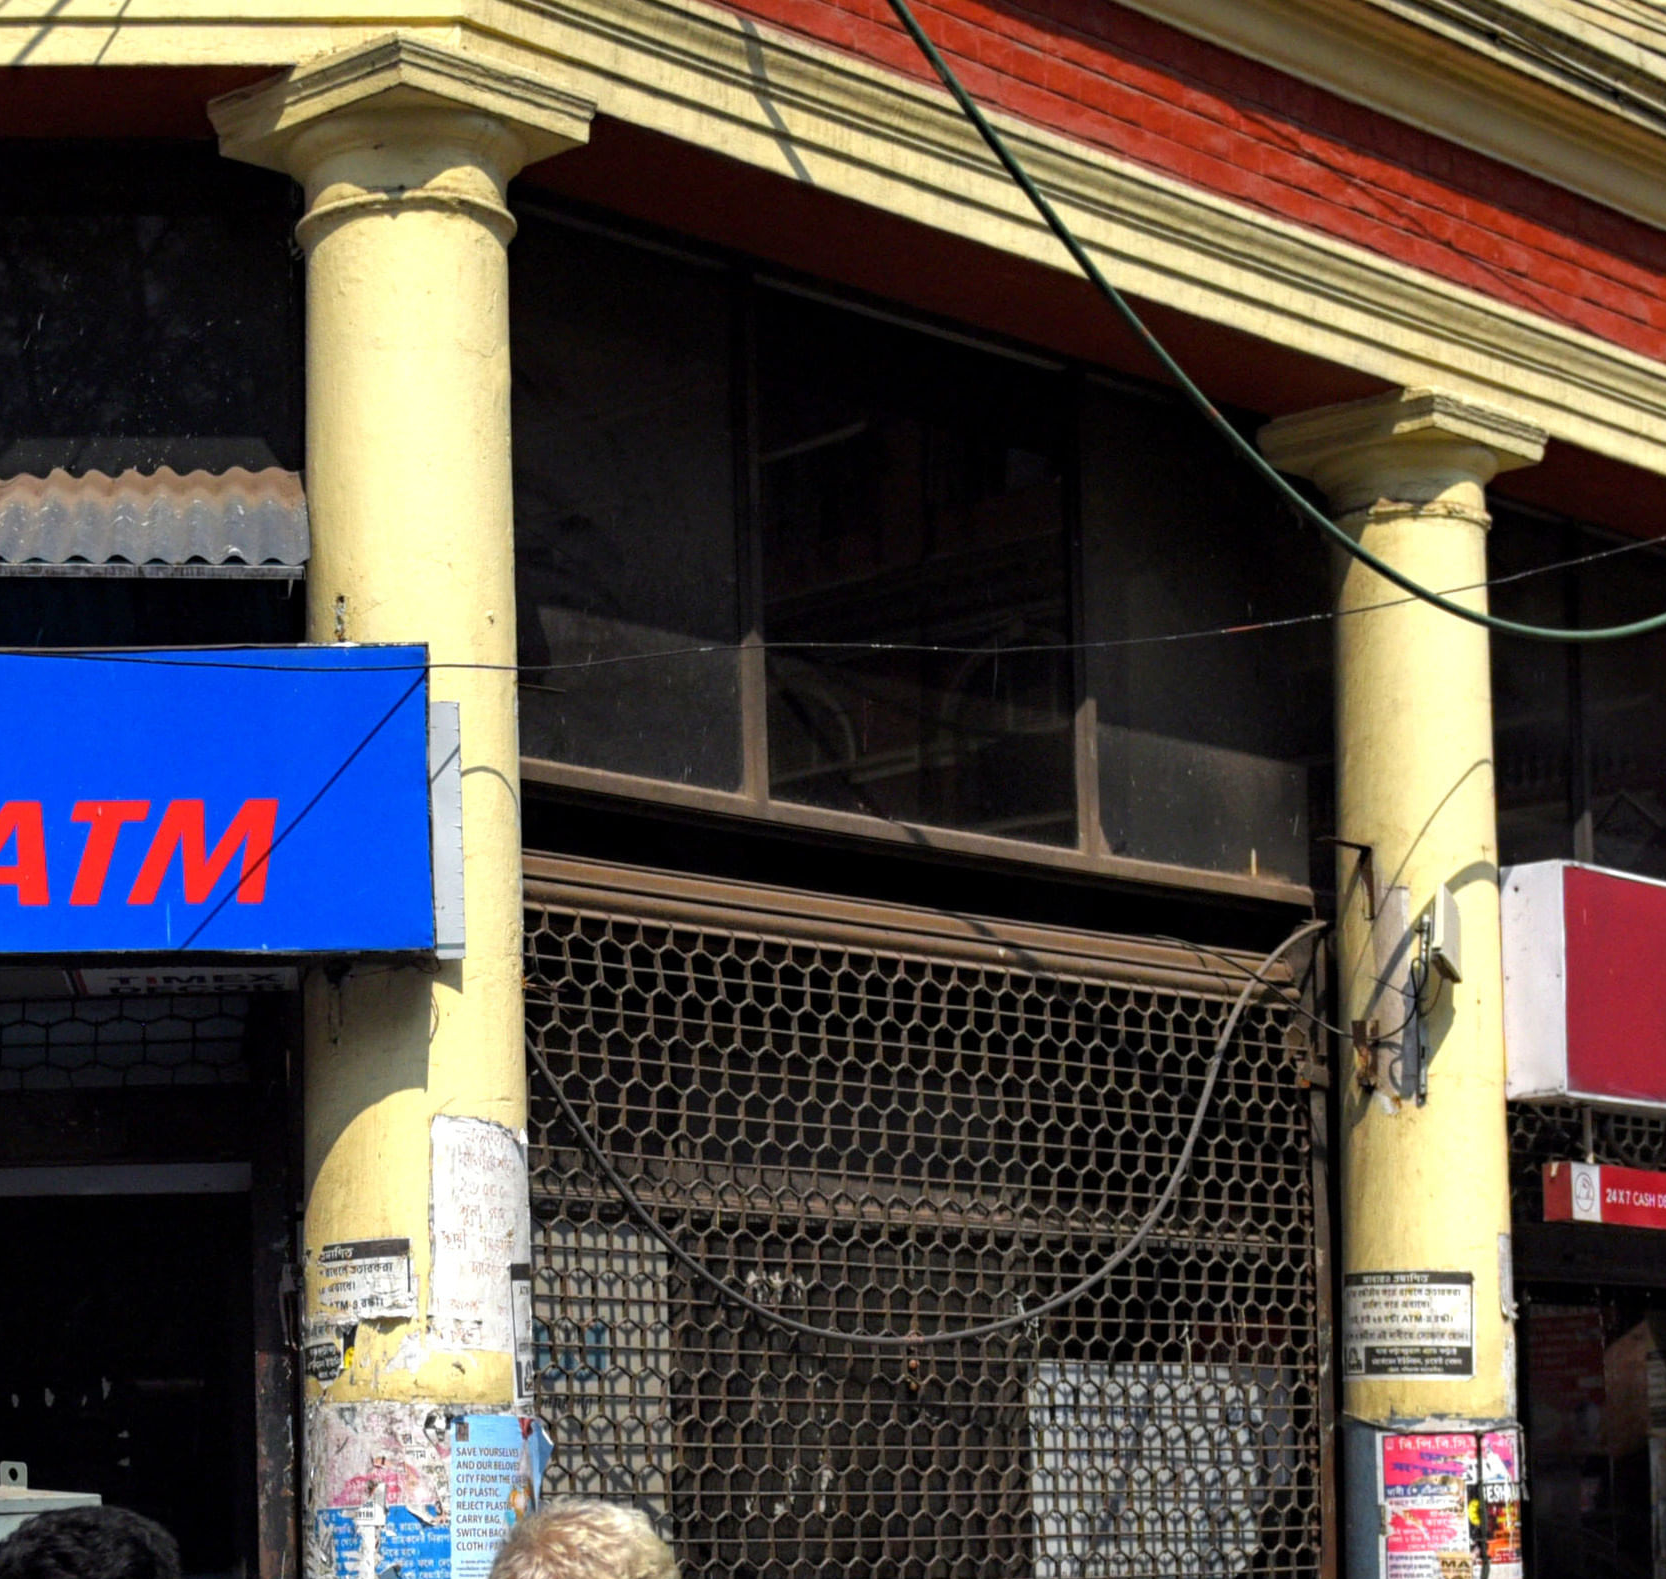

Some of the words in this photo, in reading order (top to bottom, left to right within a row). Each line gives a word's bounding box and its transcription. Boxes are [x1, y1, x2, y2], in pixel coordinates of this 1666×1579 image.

[1633, 1192, 1656, 1209] CASH
[456, 1447, 477, 1457] SAVE
[456, 1461, 475, 1470] AND
[476, 1461, 493, 1470] OUR
[456, 1474, 475, 1483] CITY
[476, 1474, 498, 1483] FROM
[500, 1474, 510, 1483] THE
[456, 1488, 467, 1497] OF
[456, 1501, 484, 1510] REJECT
[456, 1515, 482, 1524] CARRY
[456, 1528, 487, 1537] SWITCH
[456, 1541, 483, 1551] CLOTH
